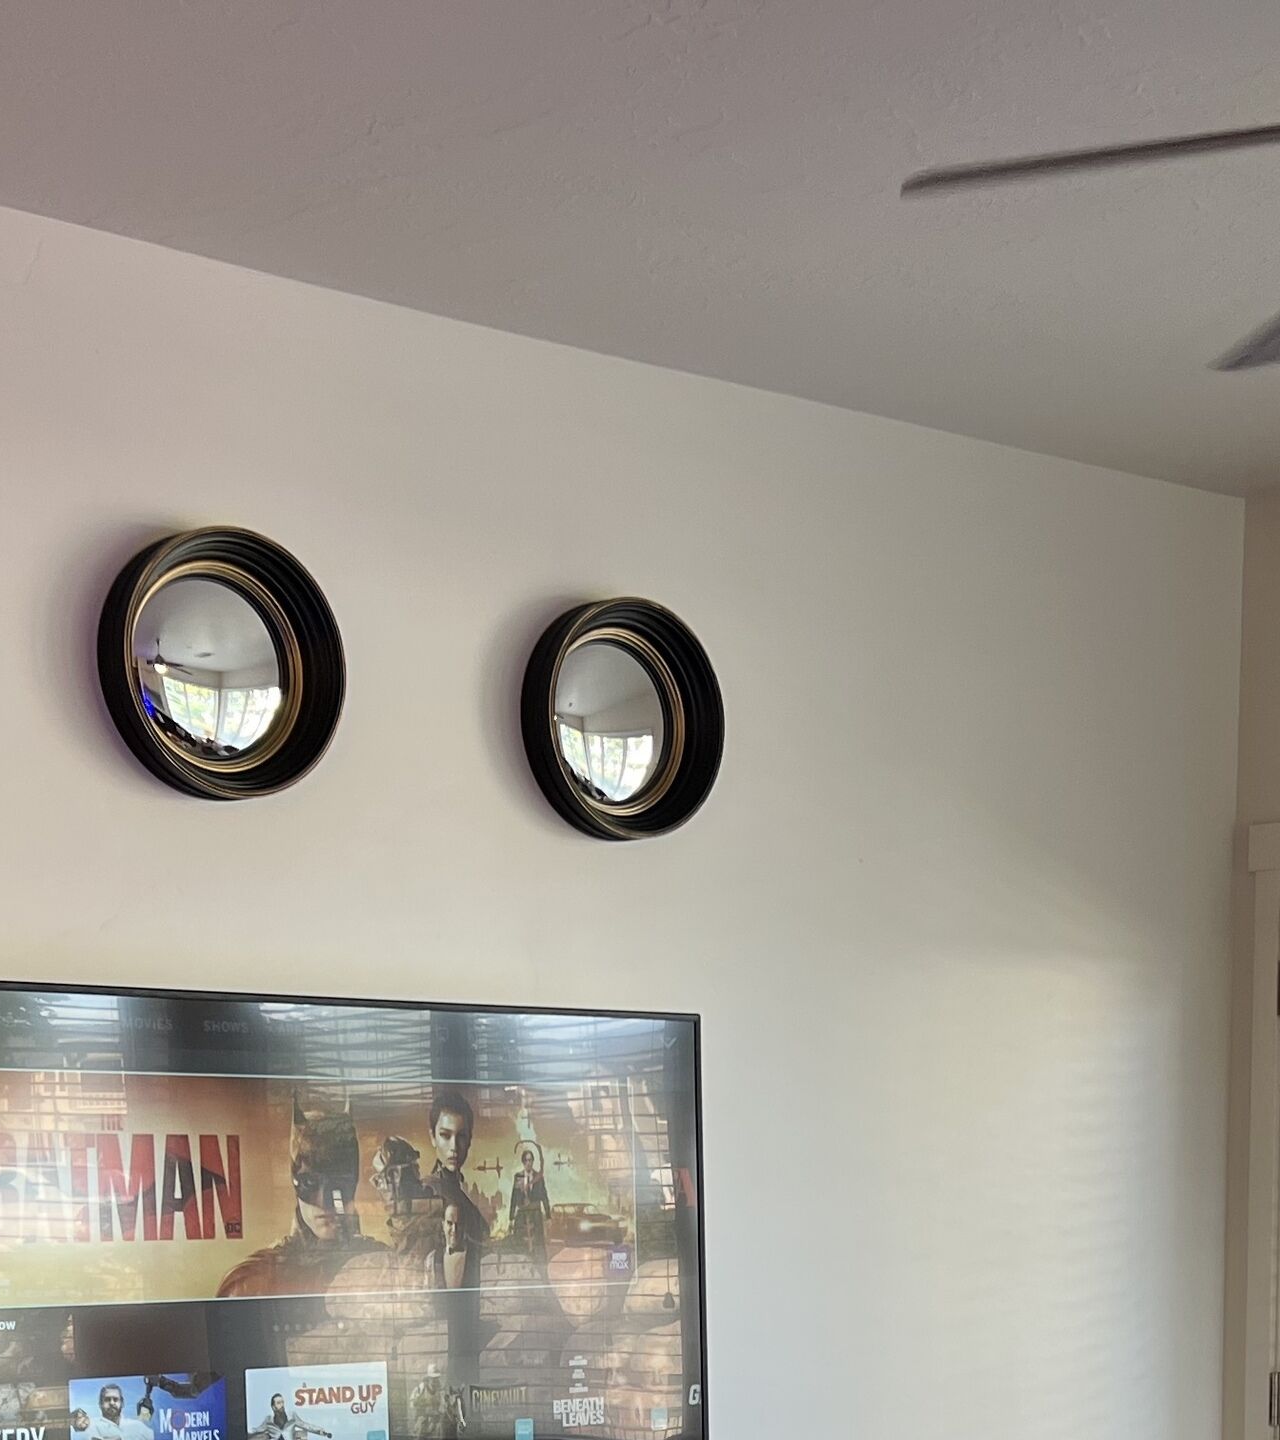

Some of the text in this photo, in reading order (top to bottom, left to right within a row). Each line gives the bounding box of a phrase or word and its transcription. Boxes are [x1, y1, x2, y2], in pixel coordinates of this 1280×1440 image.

[203, 1019, 248, 1033] SHOWS
[294, 1384, 383, 1407] STAND UP
[350, 1402, 376, 1414] GUY
[553, 1397, 605, 1414] BENEATH
[159, 1408, 210, 1434] MODERN
[562, 1411, 605, 1428] LEAVES
